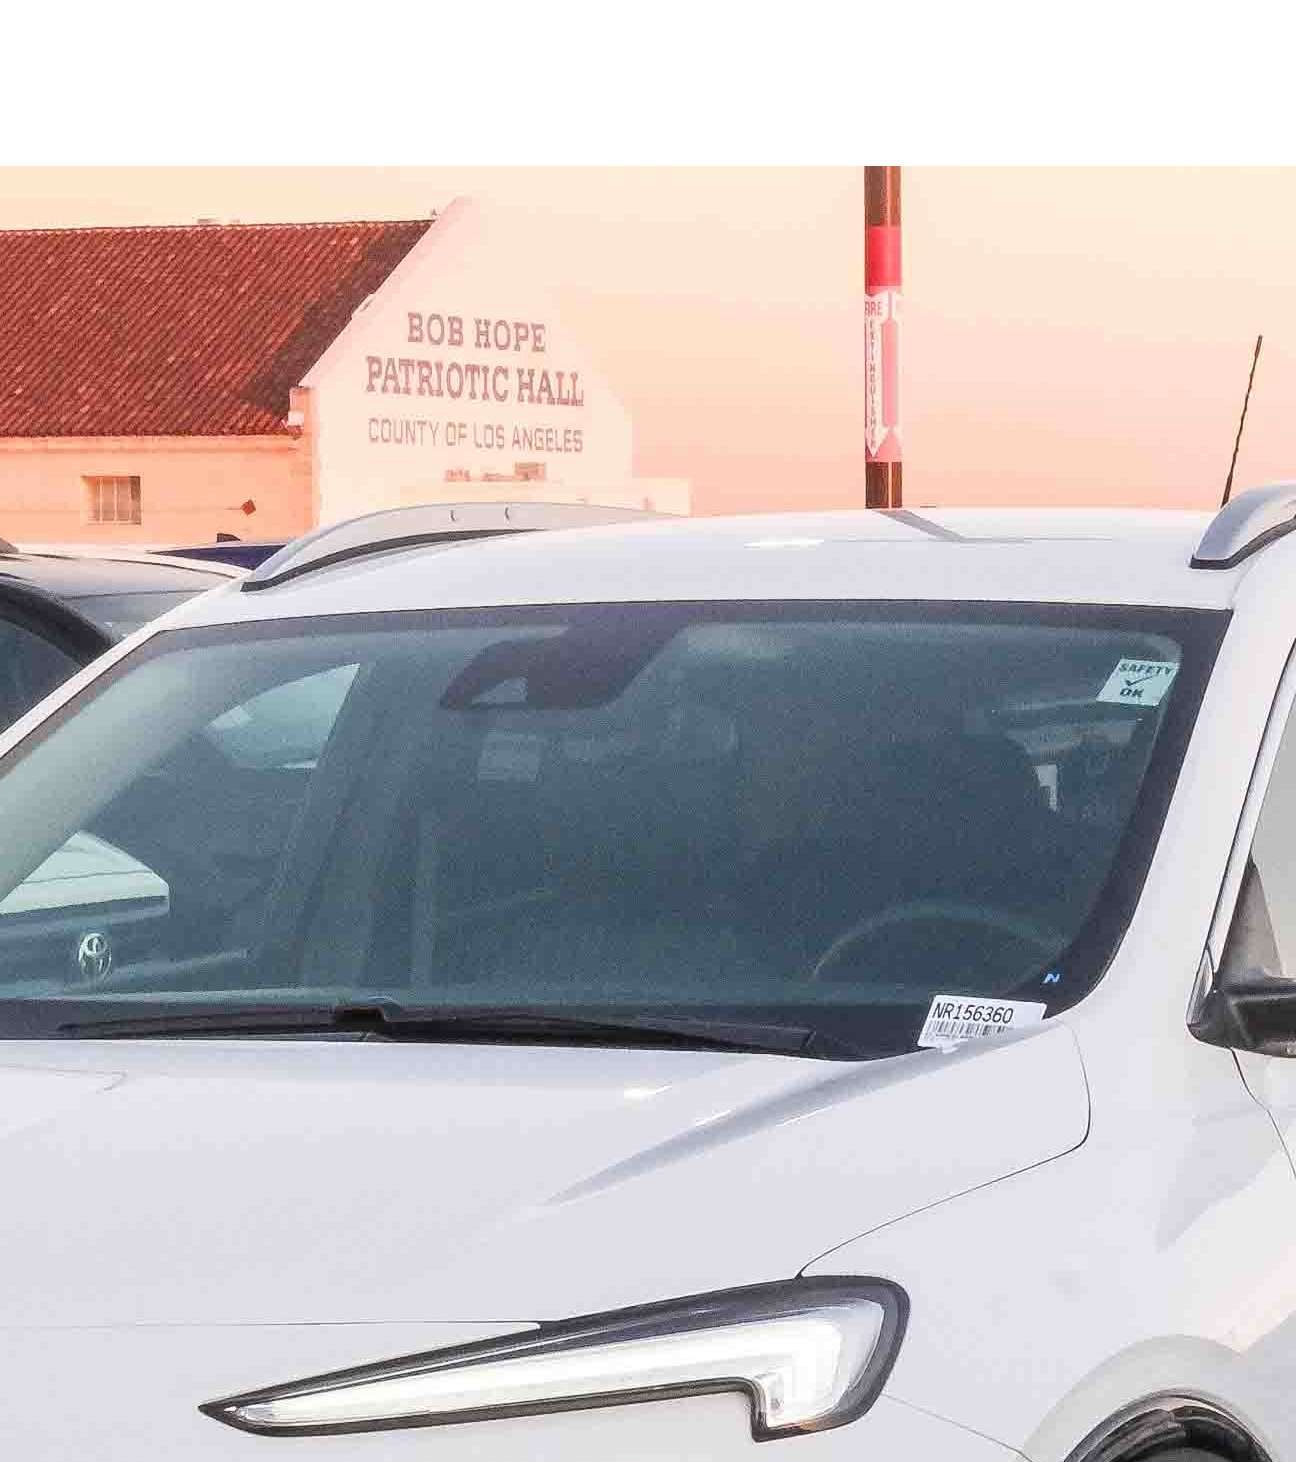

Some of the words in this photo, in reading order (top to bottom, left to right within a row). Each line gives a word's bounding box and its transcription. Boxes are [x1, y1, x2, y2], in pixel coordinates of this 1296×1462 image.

[407, 312, 464, 348] BOB
[474, 318, 546, 352] HOPE
[365, 355, 509, 401] PATRIOTIC
[516, 367, 584, 406] HALL
[368, 417, 440, 444] COUNTY
[445, 421, 467, 447] OF
[473, 423, 505, 449] LOS
[511, 425, 583, 452] ANGELES
[1119, 663, 1174, 675] SAFETY
[1120, 688, 1144, 698] OK
[932, 1002, 1014, 1024] NR156360
